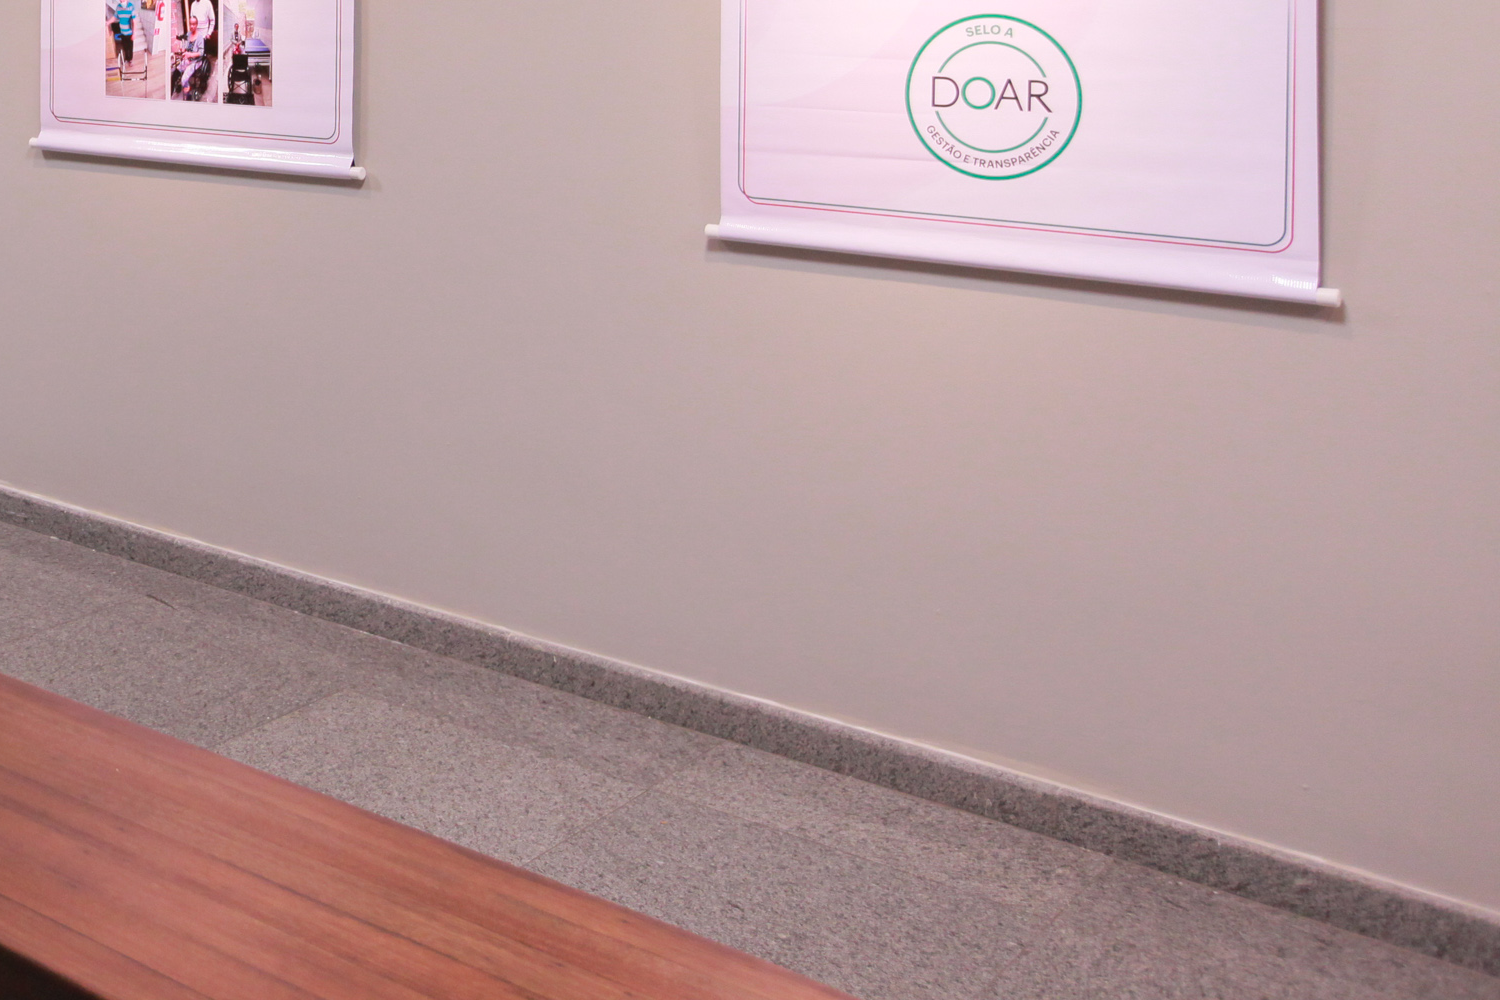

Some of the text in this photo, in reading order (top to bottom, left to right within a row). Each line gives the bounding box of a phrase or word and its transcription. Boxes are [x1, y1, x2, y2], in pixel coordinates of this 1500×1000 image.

[965, 24, 1013, 38] SELO A
[931, 76, 1053, 113] DOAR
[926, 125, 1060, 169] GESTÃO E TRANSPARÊNCIA
